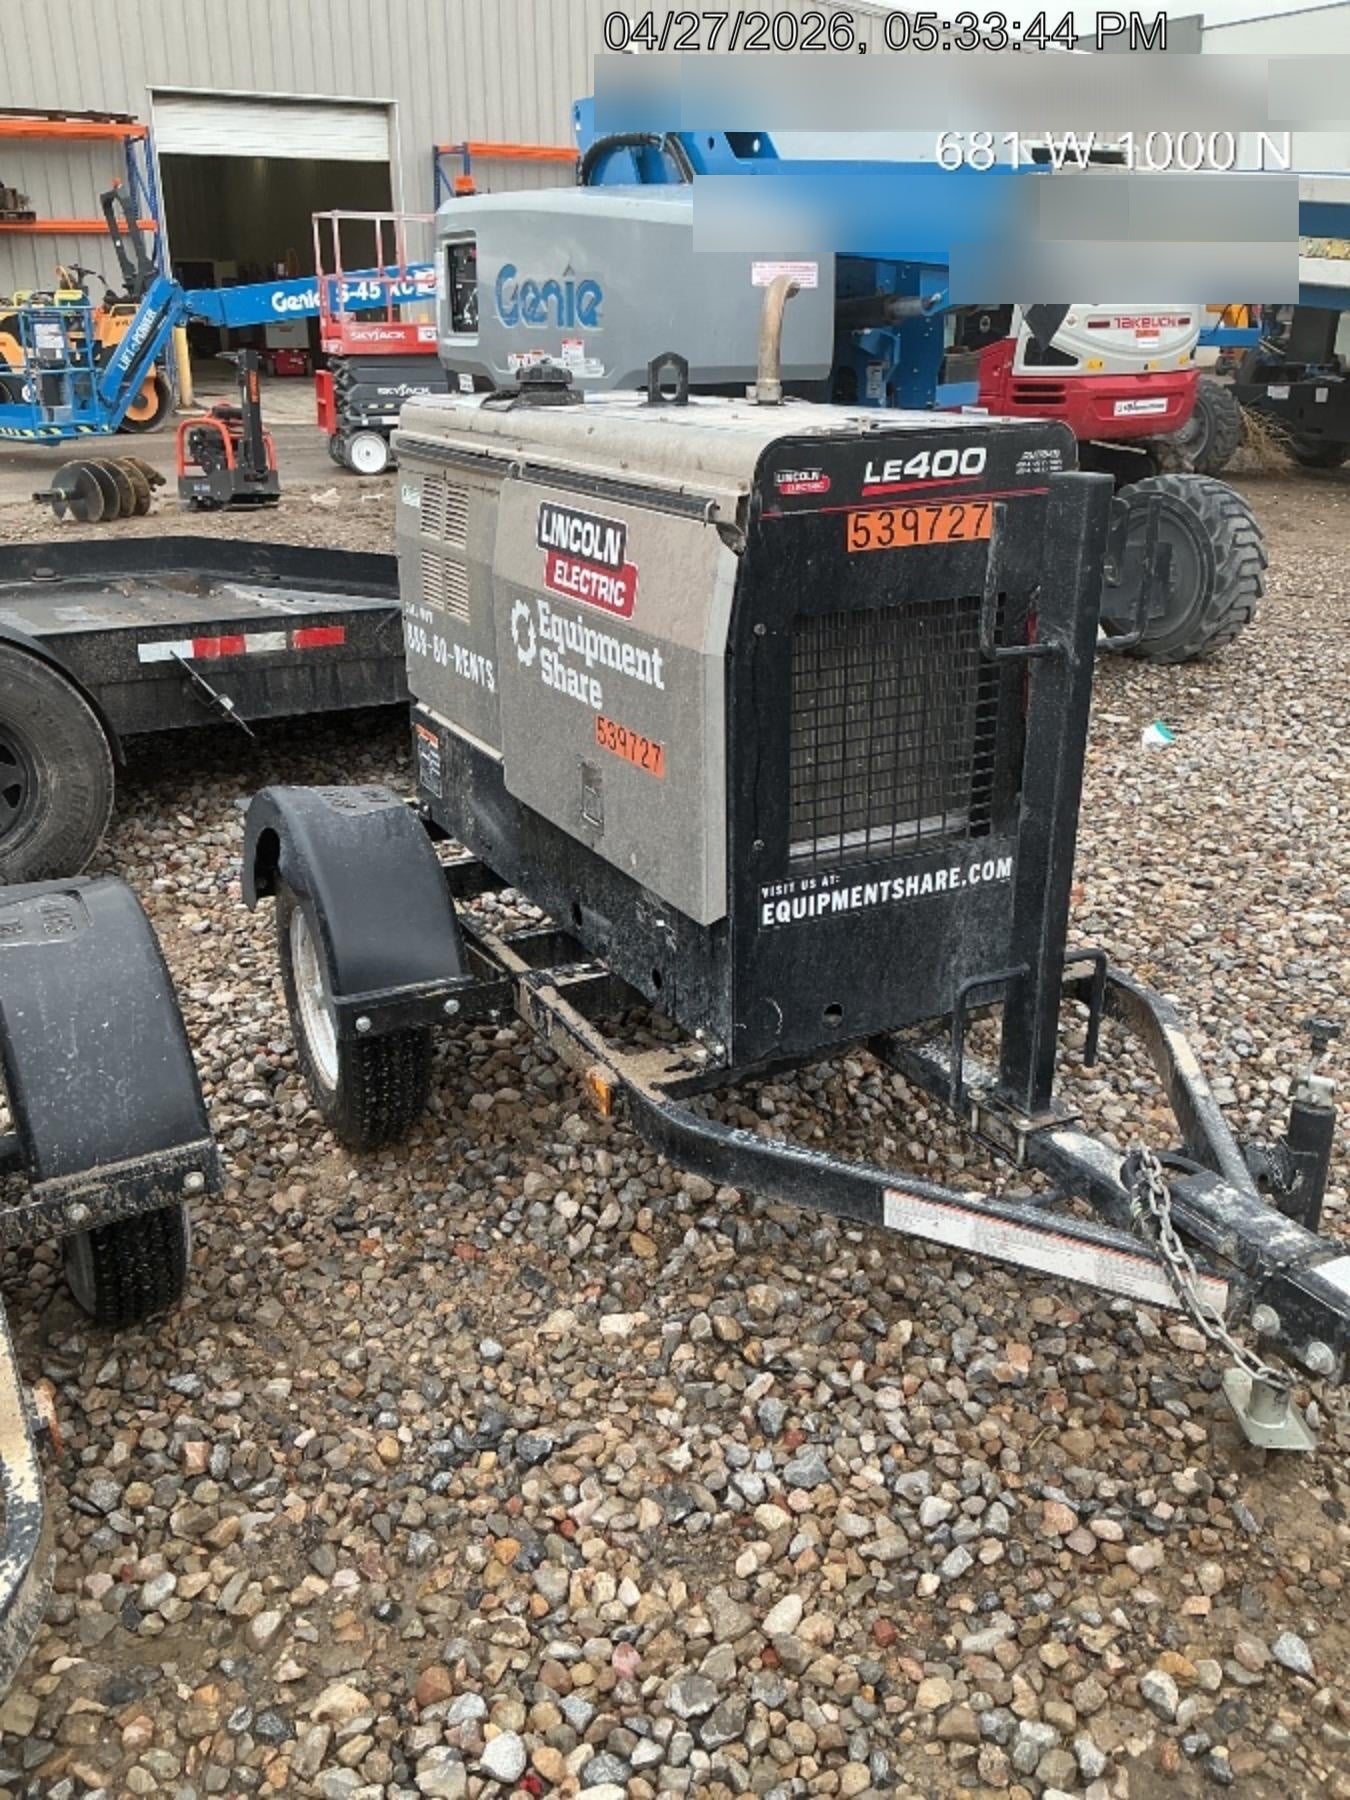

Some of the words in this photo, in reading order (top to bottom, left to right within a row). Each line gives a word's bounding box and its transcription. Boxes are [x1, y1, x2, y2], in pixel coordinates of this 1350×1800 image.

[496, 263, 604, 329] Genie
[350, 328, 406, 342] SKYJACK
[377, 383, 431, 396] SKYJACK
[777, 471, 820, 483] LINCOLN
[864, 448, 987, 483] LE400
[541, 510, 621, 566] LINCOLN
[852, 503, 989, 549] 539727
[553, 559, 627, 607] ELECTRIC
[536, 599, 665, 690] Equipment
[540, 647, 603, 710] Share
[597, 716, 662, 774] 539727
[761, 882, 795, 898] VISIT
[801, 878, 817, 892] US
[821, 875, 841, 888] AT:
[762, 857, 1013, 925] EQUIPMENTSHARE.COM
